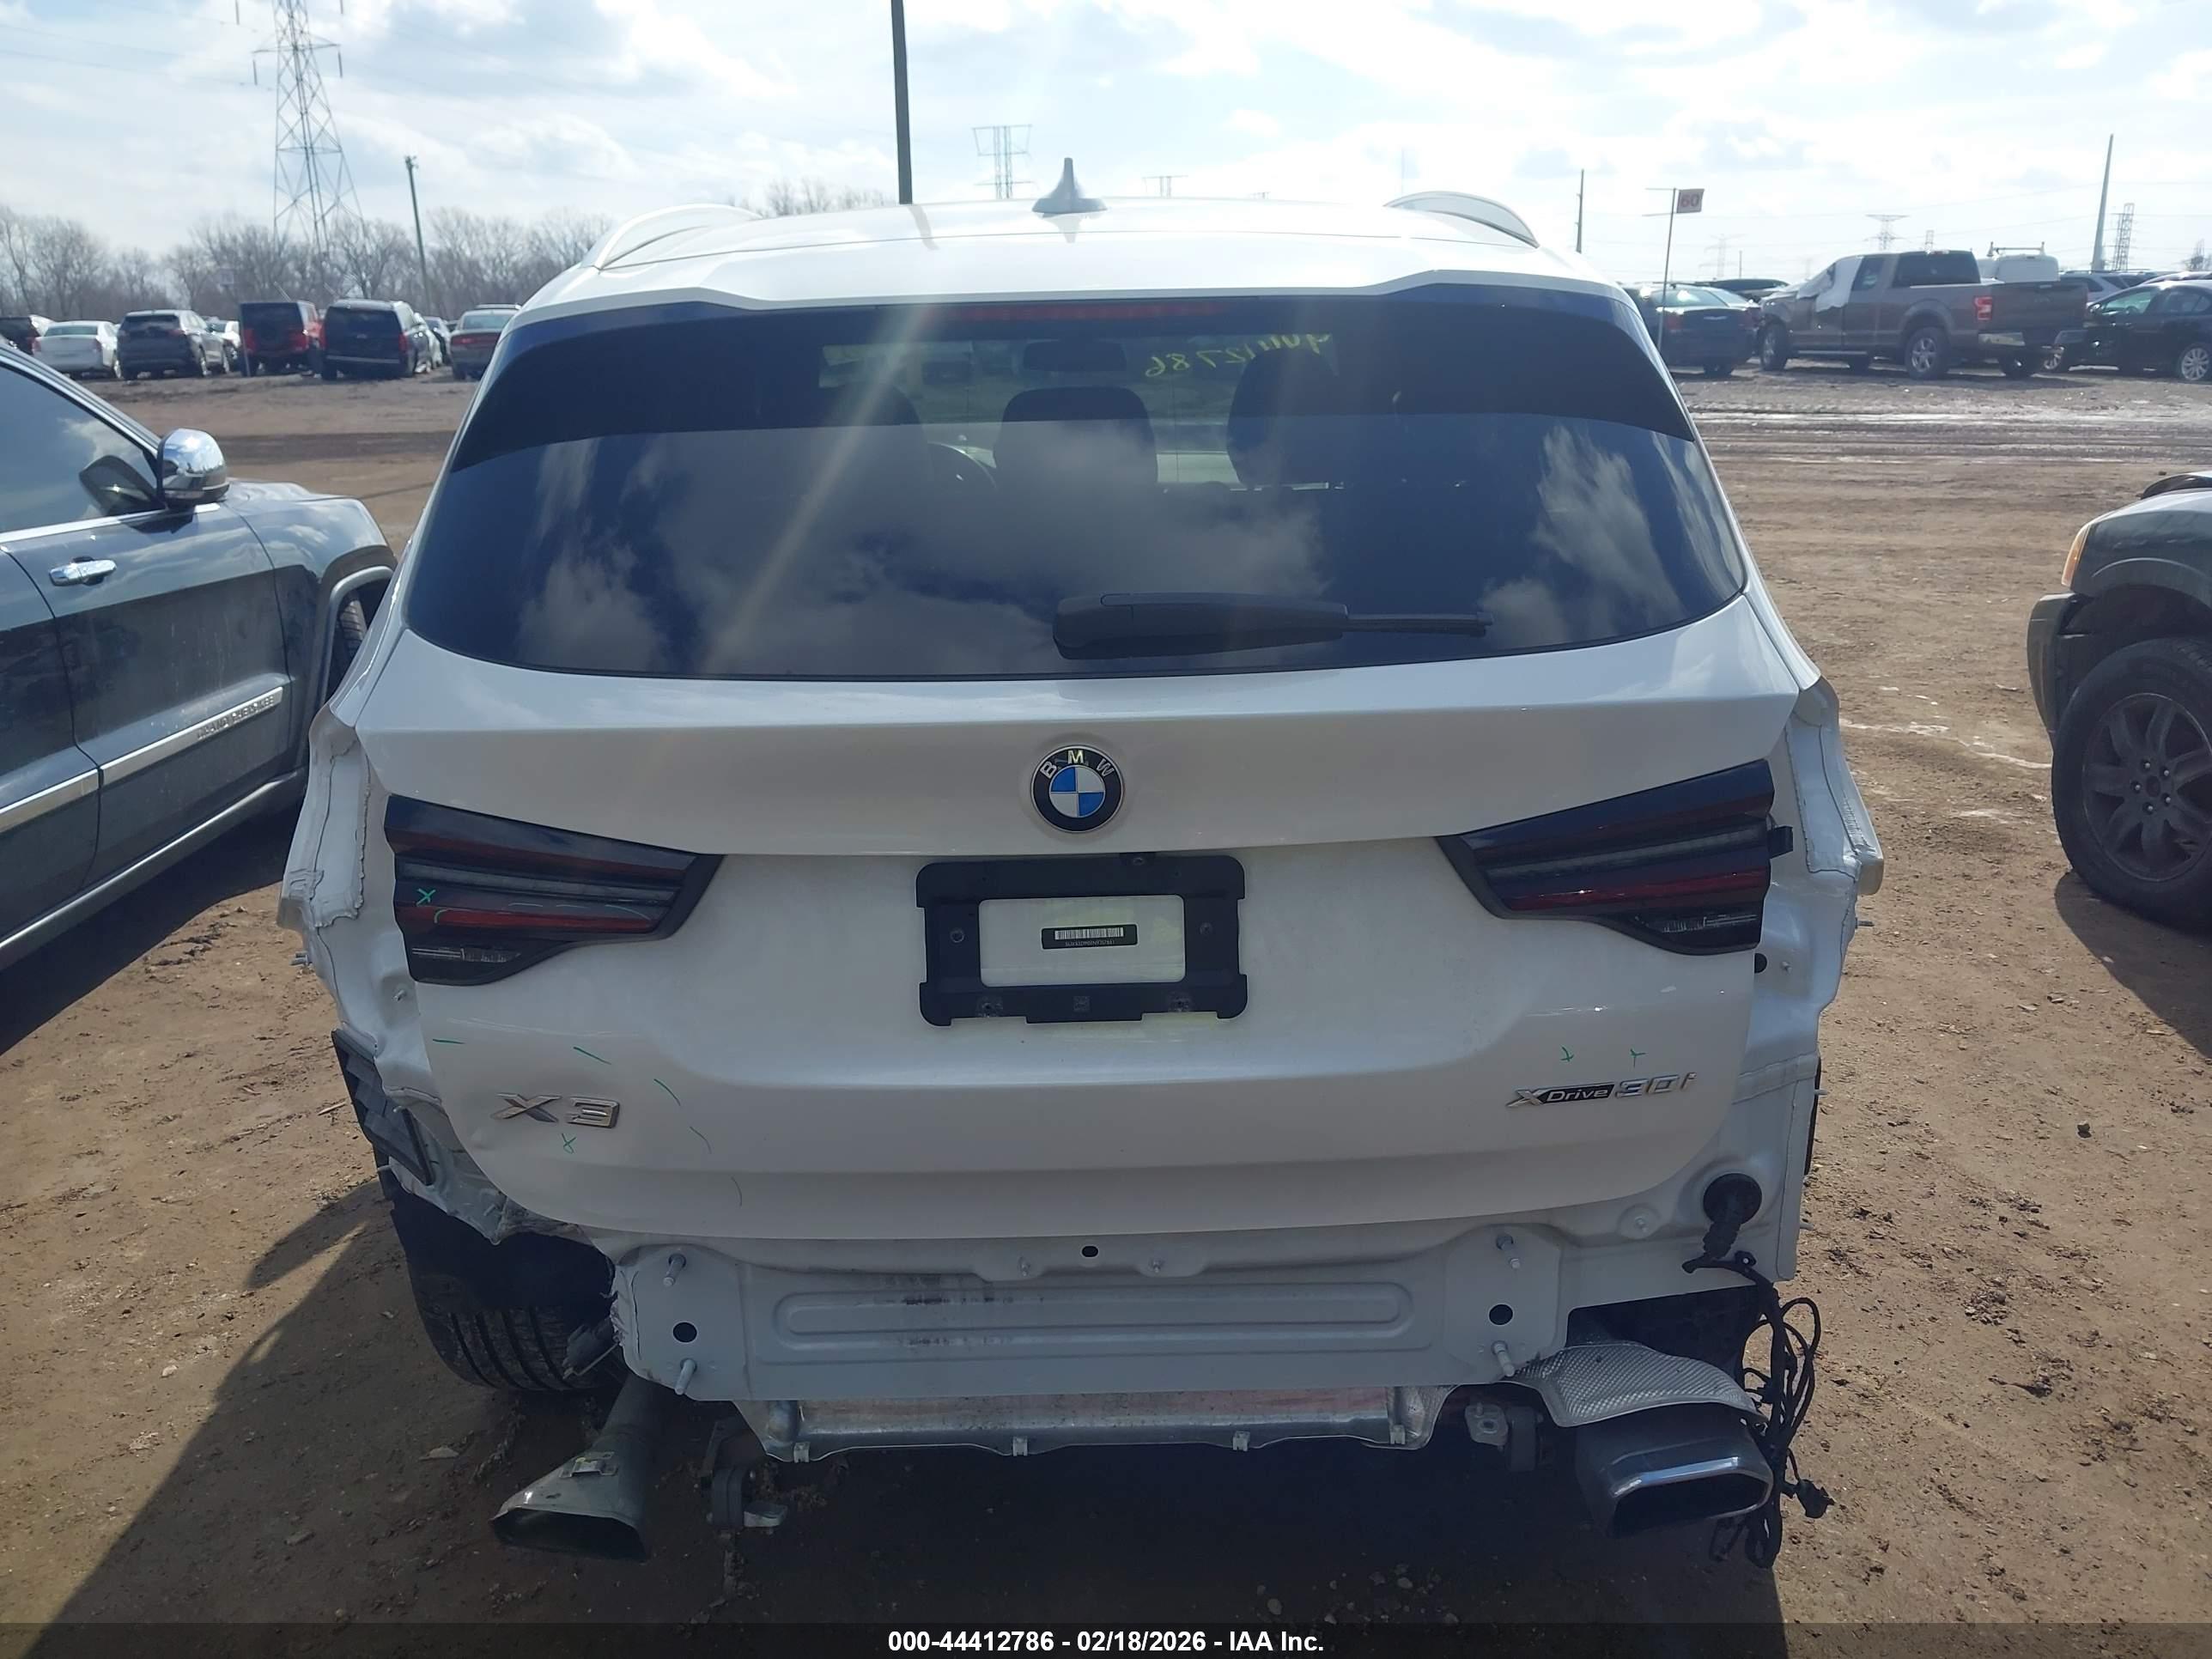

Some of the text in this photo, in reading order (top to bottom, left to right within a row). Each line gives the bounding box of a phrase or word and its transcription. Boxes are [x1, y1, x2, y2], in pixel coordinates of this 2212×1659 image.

[1040, 750, 1115, 779] BMW
[1614, 1072, 1697, 1100] 30i
[489, 1091, 620, 1130] X3
